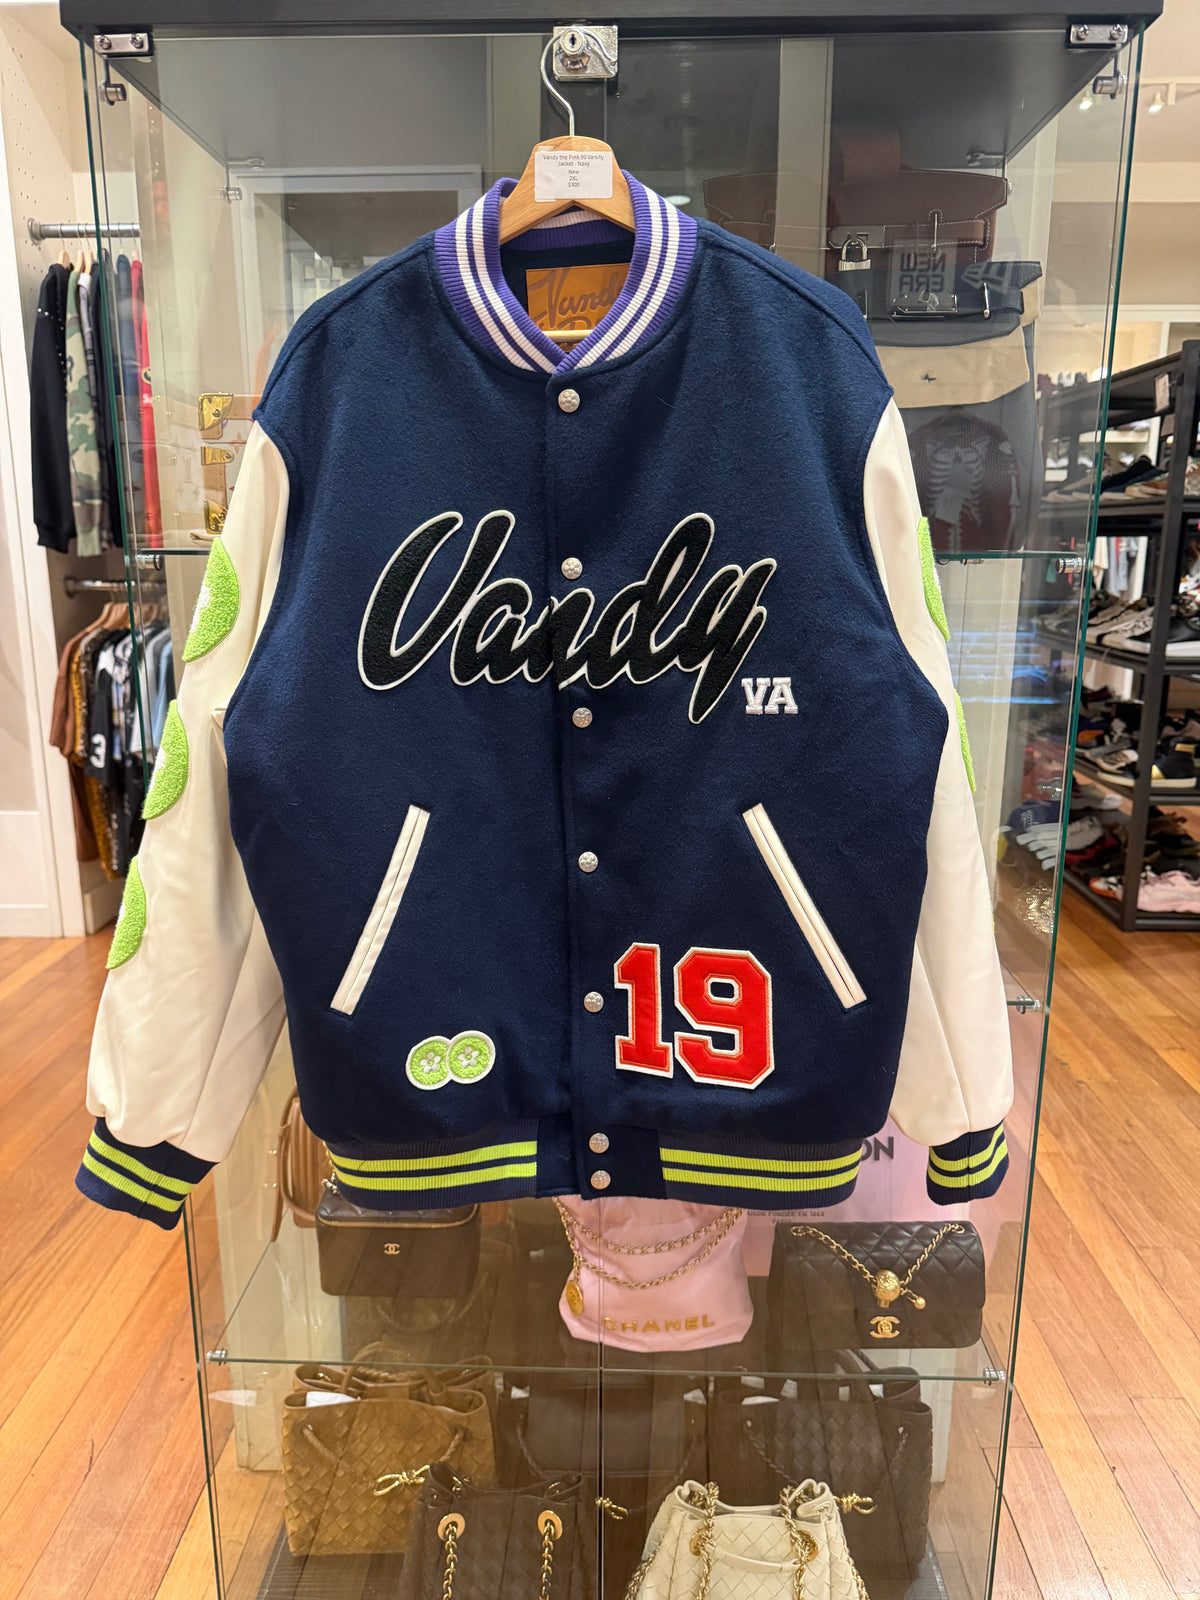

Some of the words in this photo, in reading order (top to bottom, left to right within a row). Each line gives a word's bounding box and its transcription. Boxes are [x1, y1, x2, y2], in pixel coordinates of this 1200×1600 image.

[529, 268, 622, 328] Vand
[358, 509, 777, 724] Vandy
[741, 677, 798, 715] VA
[613, 942, 775, 1090] 19
[603, 1314, 716, 1333] CHANEL
